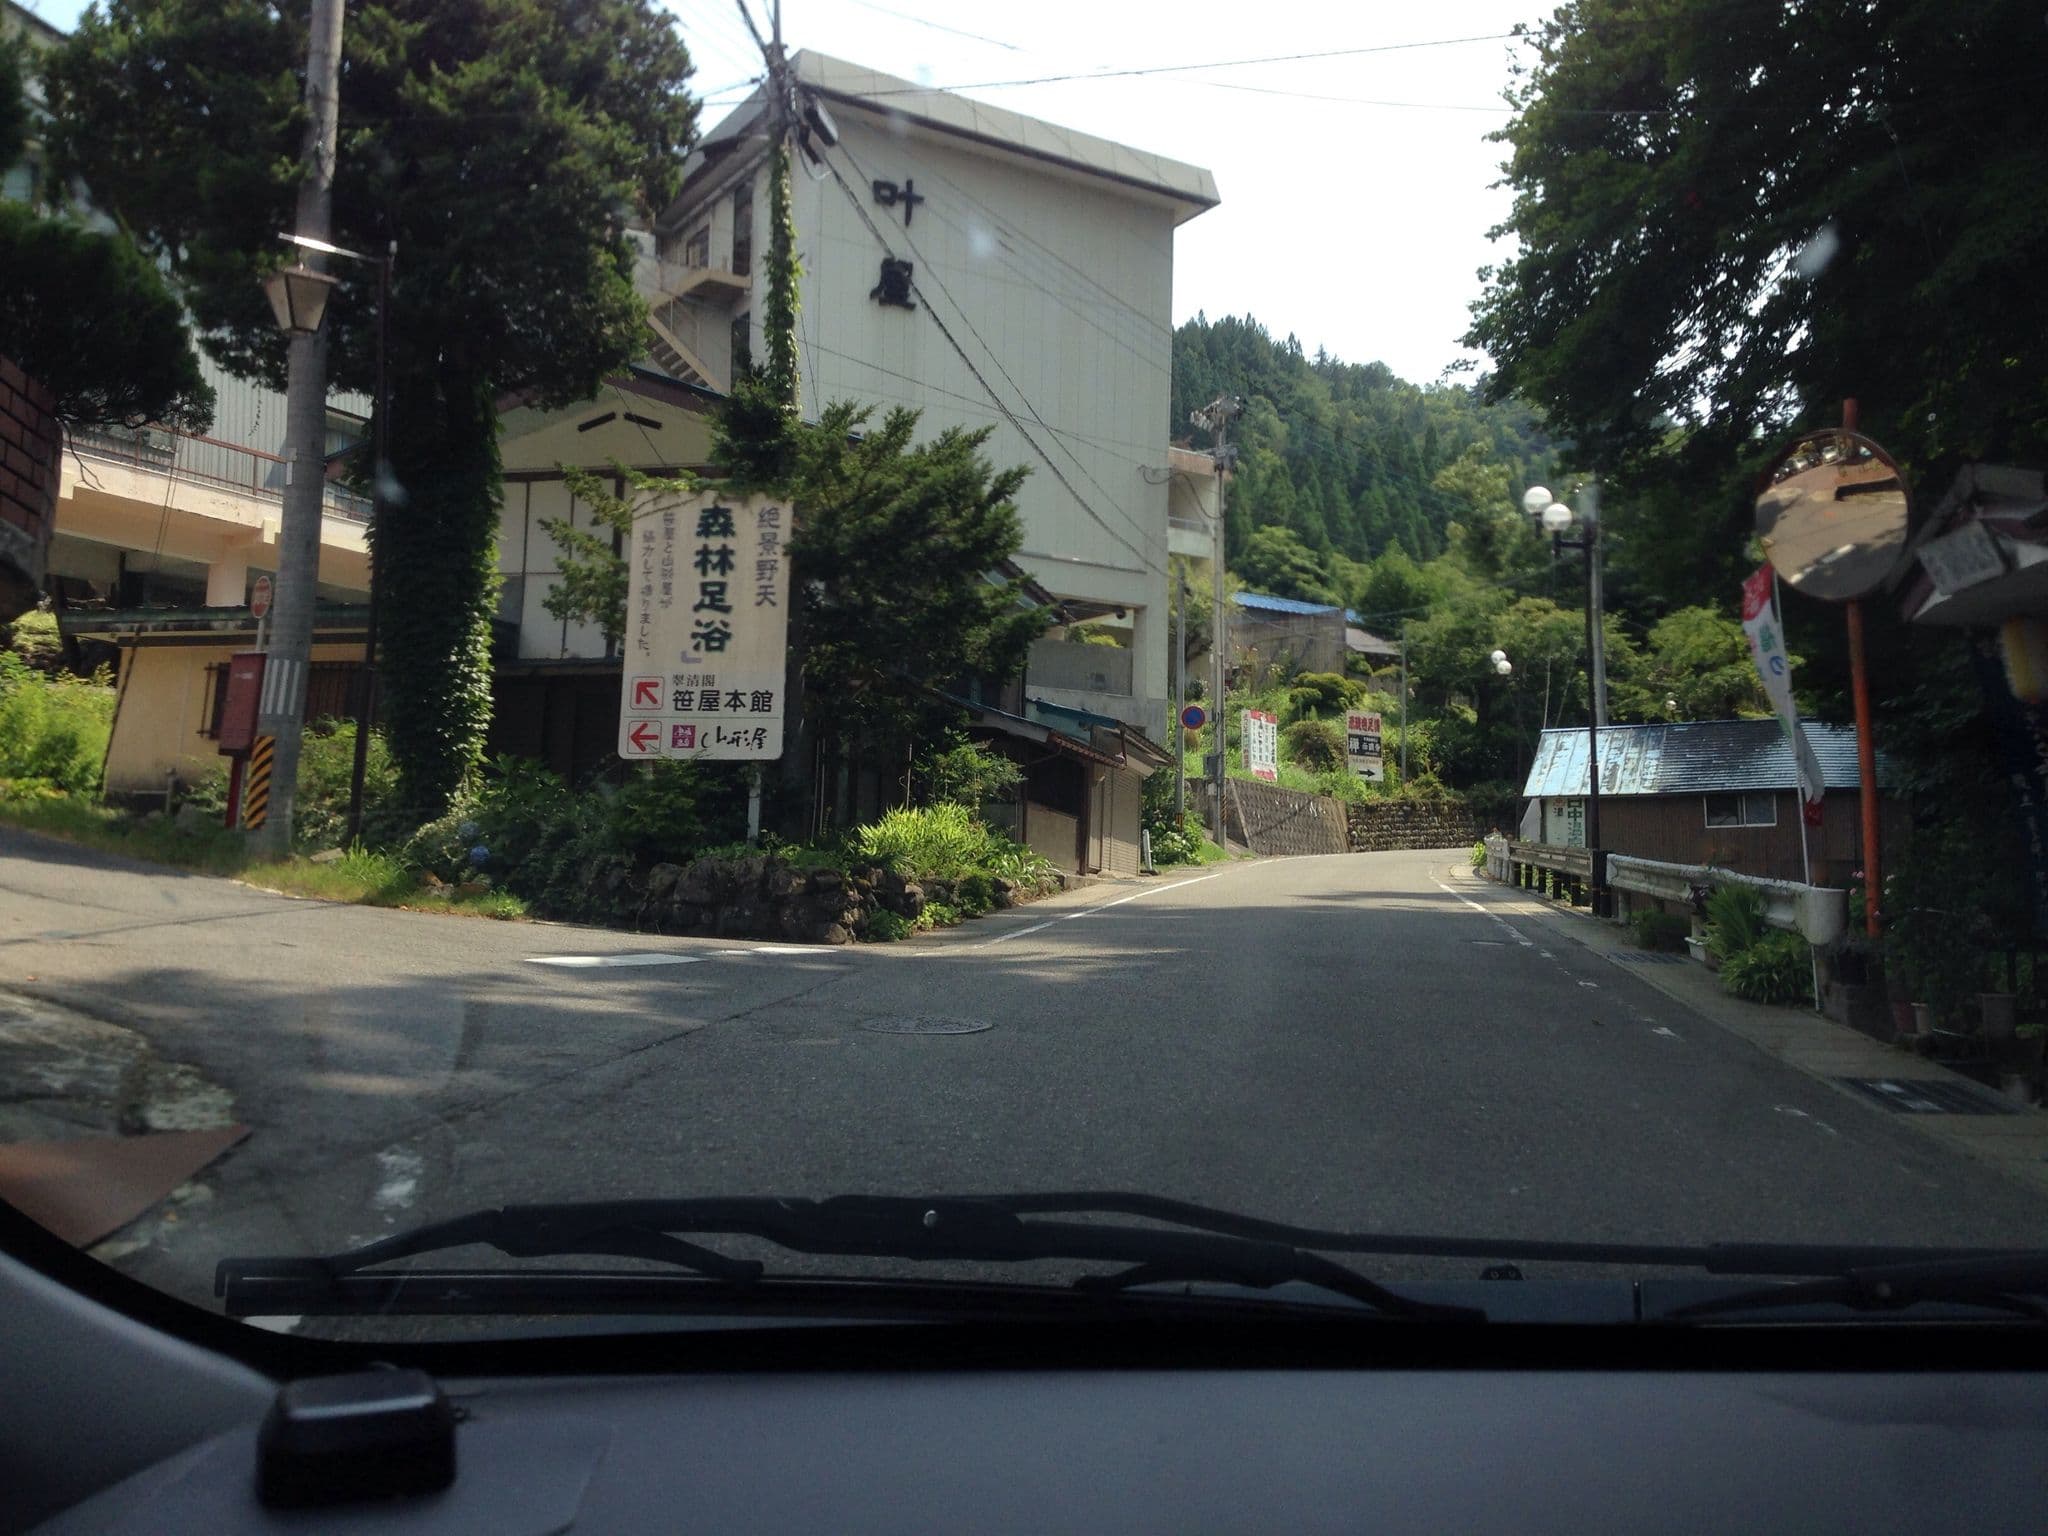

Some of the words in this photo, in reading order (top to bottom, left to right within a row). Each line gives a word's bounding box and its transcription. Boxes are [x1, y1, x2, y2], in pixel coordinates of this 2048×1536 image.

[755, 506, 781, 607] 絶景野天
[672, 689, 774, 713] 笹屋本館
